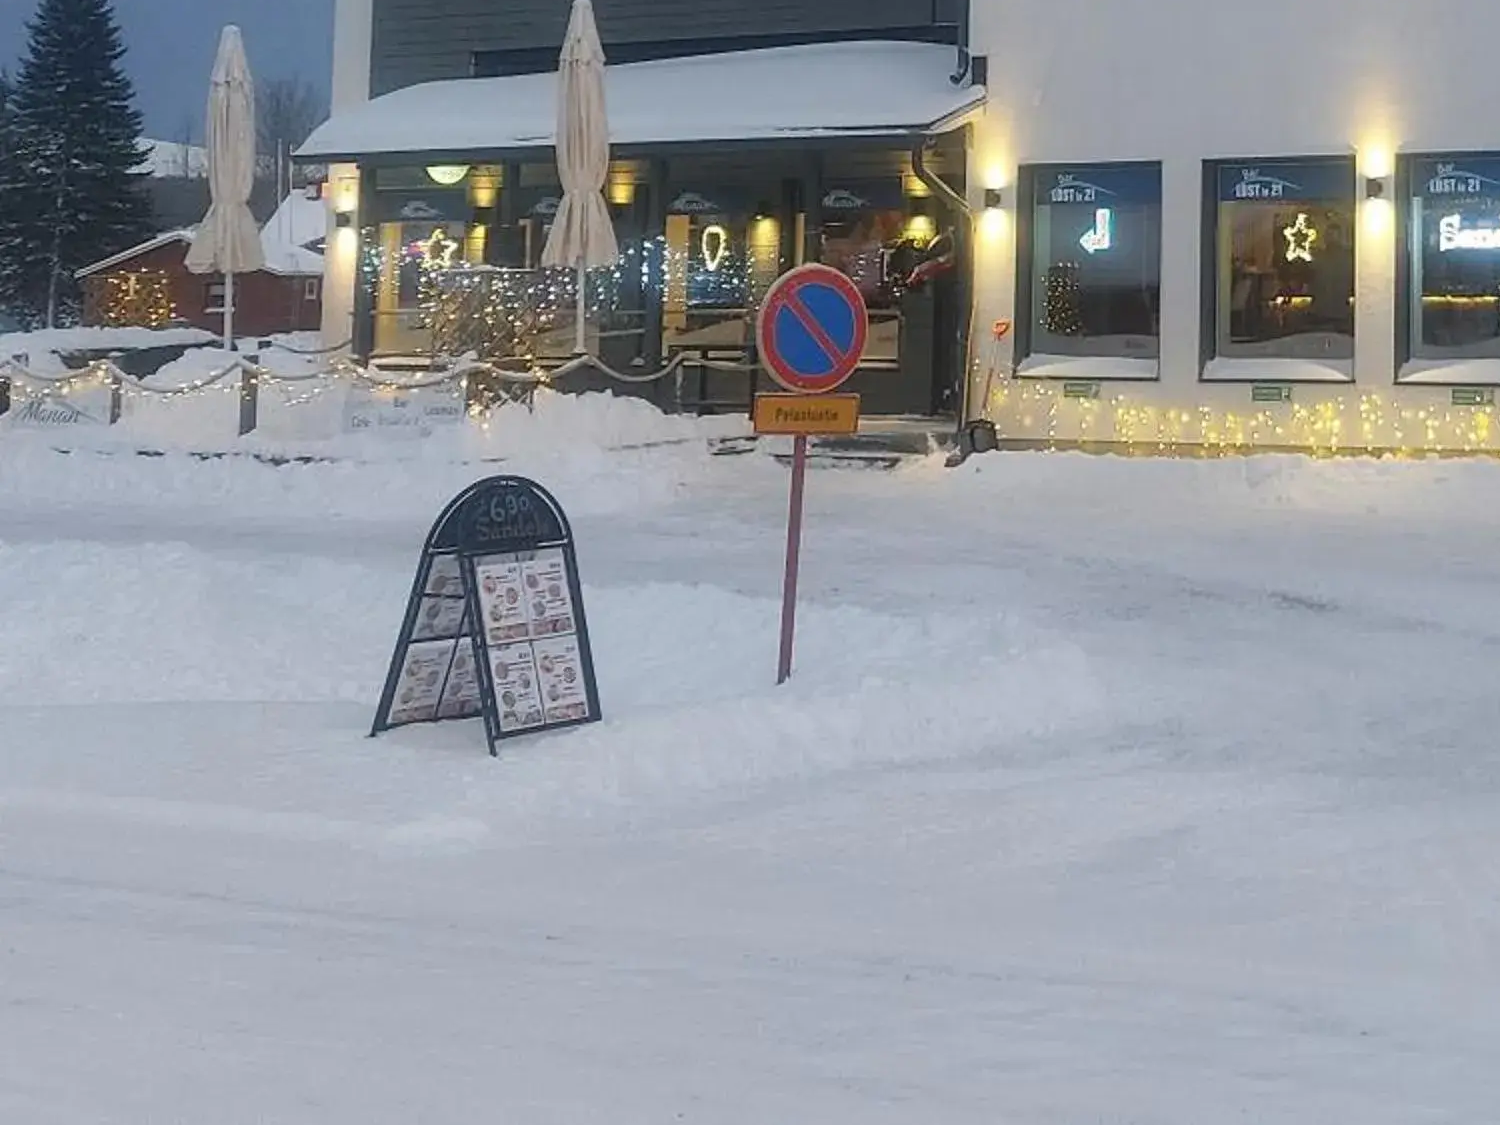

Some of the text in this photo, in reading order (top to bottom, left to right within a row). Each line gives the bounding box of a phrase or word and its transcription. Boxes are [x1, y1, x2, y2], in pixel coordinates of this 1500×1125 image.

[1235, 182, 1260, 198] LOST
[1429, 178, 1456, 192] LOST
[1051, 188, 1075, 203] LOST
